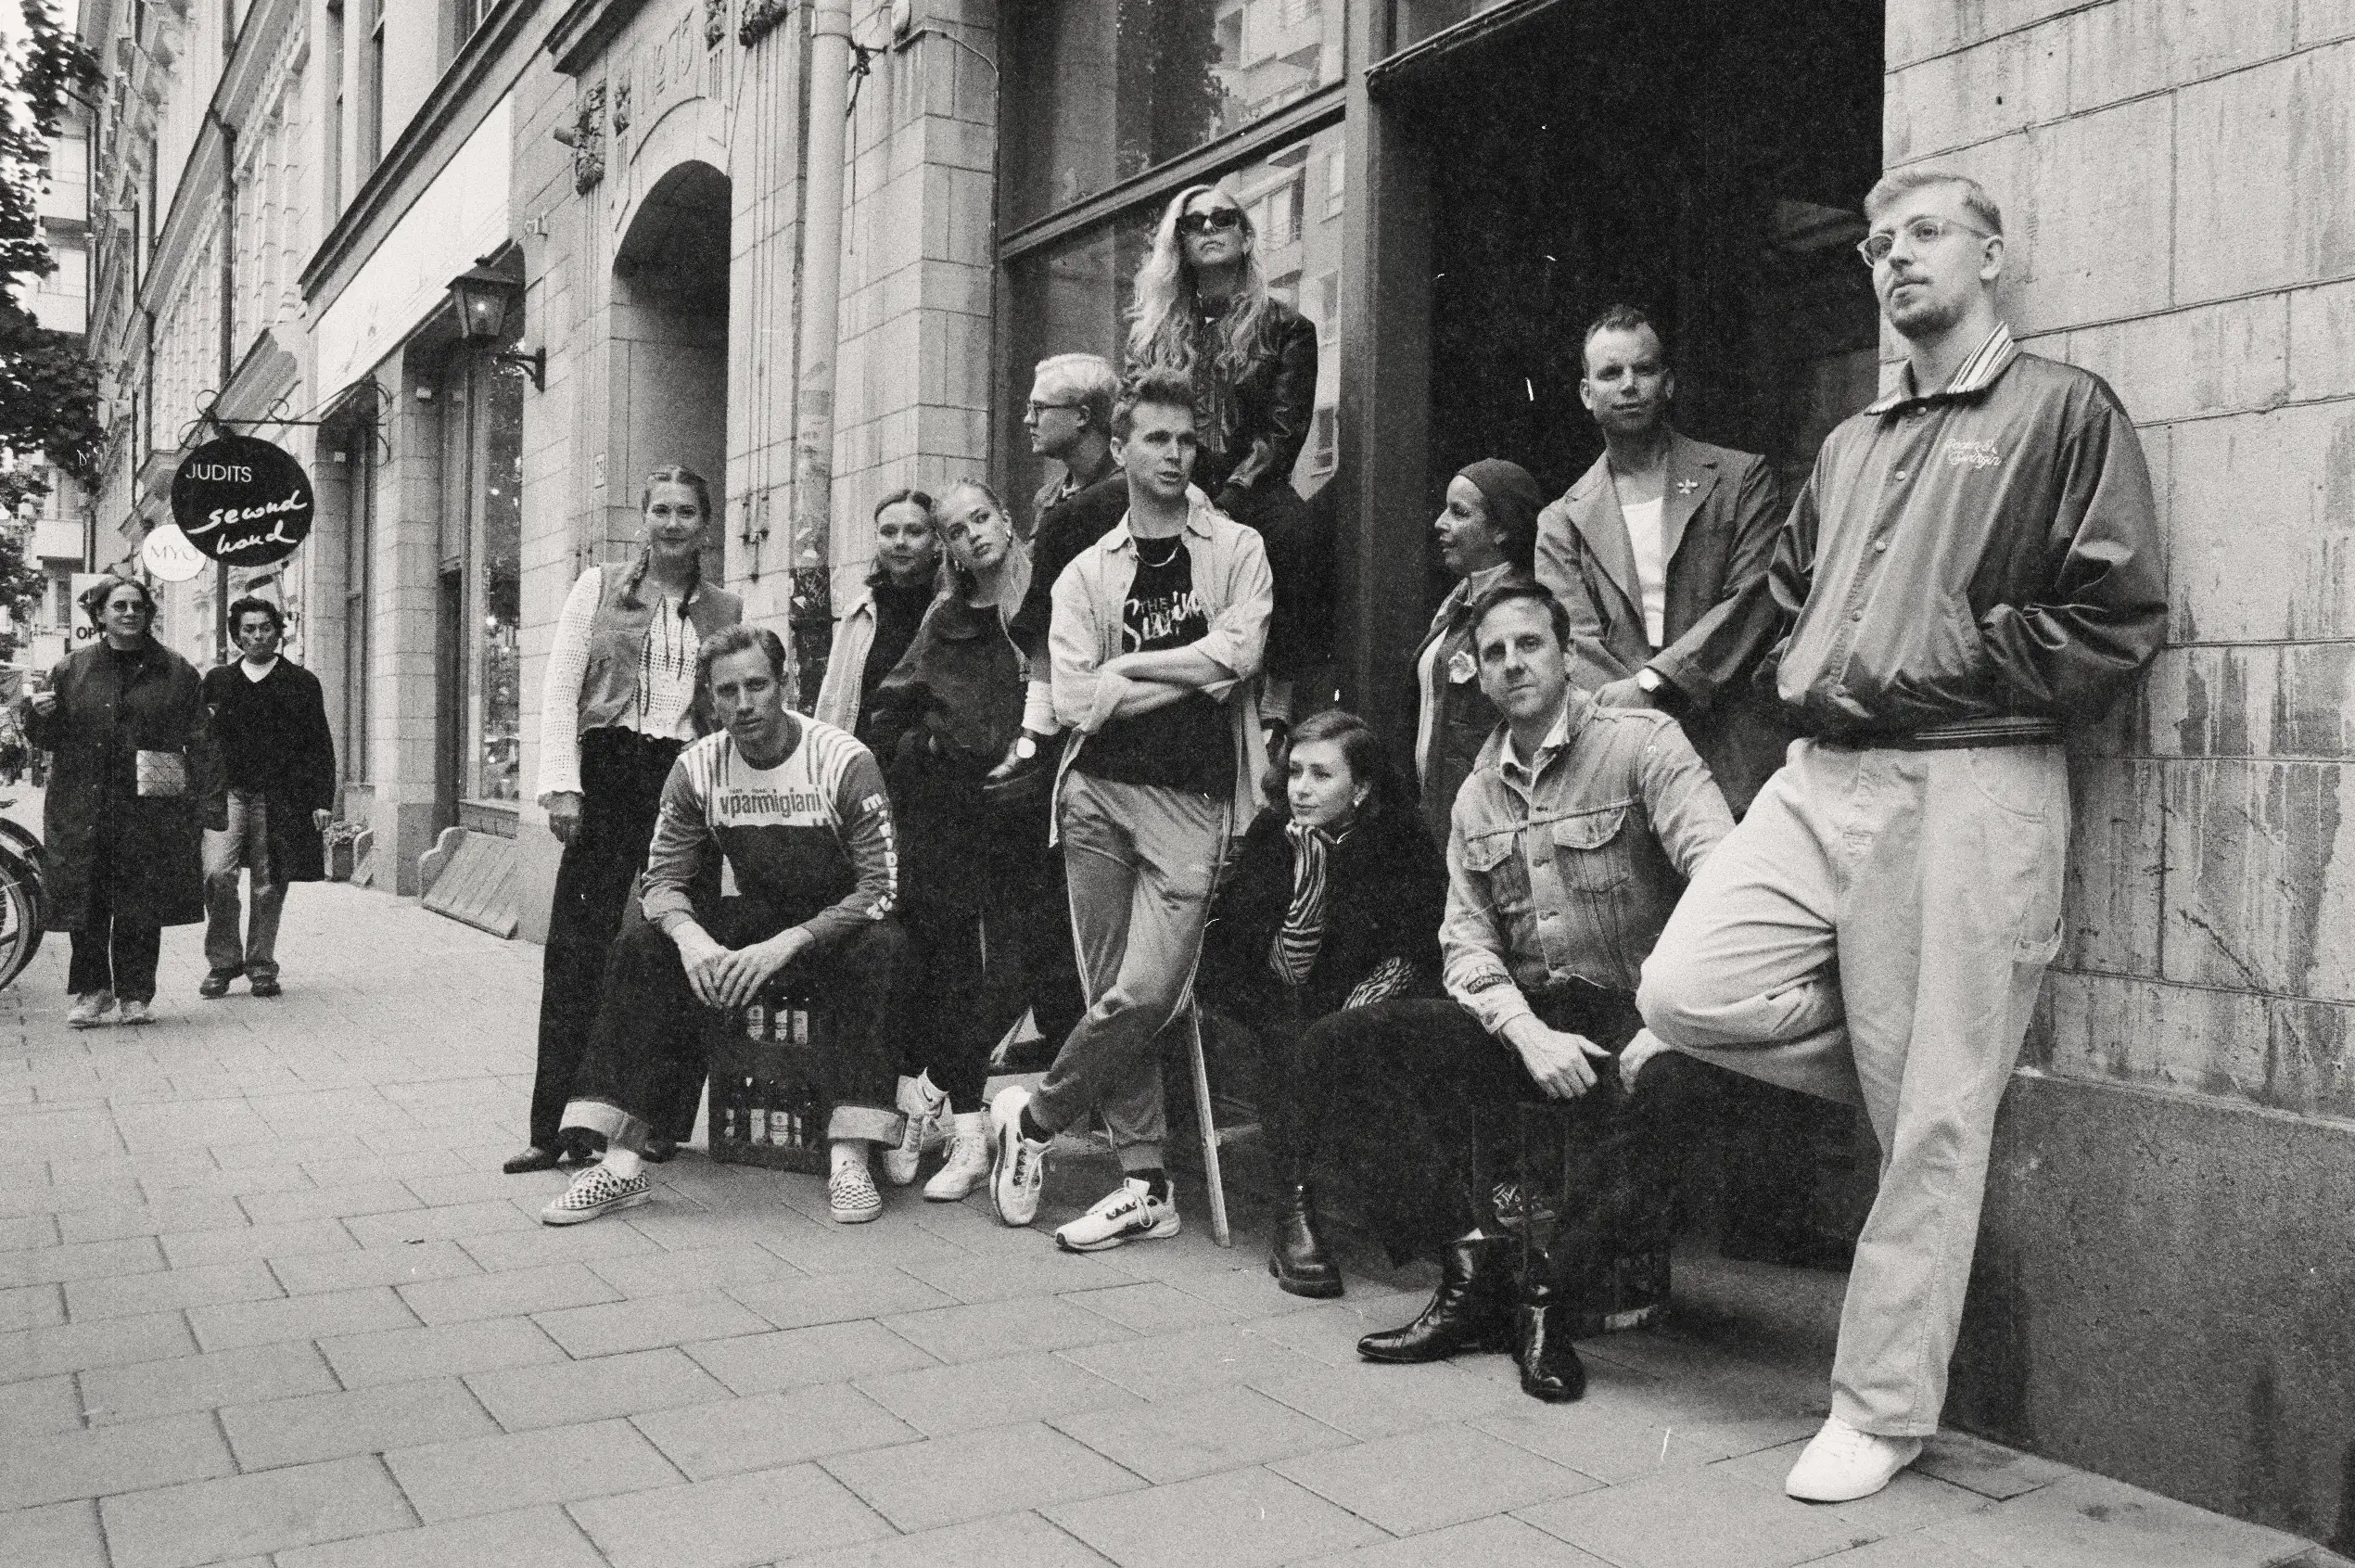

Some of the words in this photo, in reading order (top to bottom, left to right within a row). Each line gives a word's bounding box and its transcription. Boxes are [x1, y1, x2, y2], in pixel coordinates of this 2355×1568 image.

[185, 464, 252, 483] JUDITS
[186, 490, 308, 534] second
[216, 519, 298, 555] hand
[1139, 596, 1169, 614] THE
